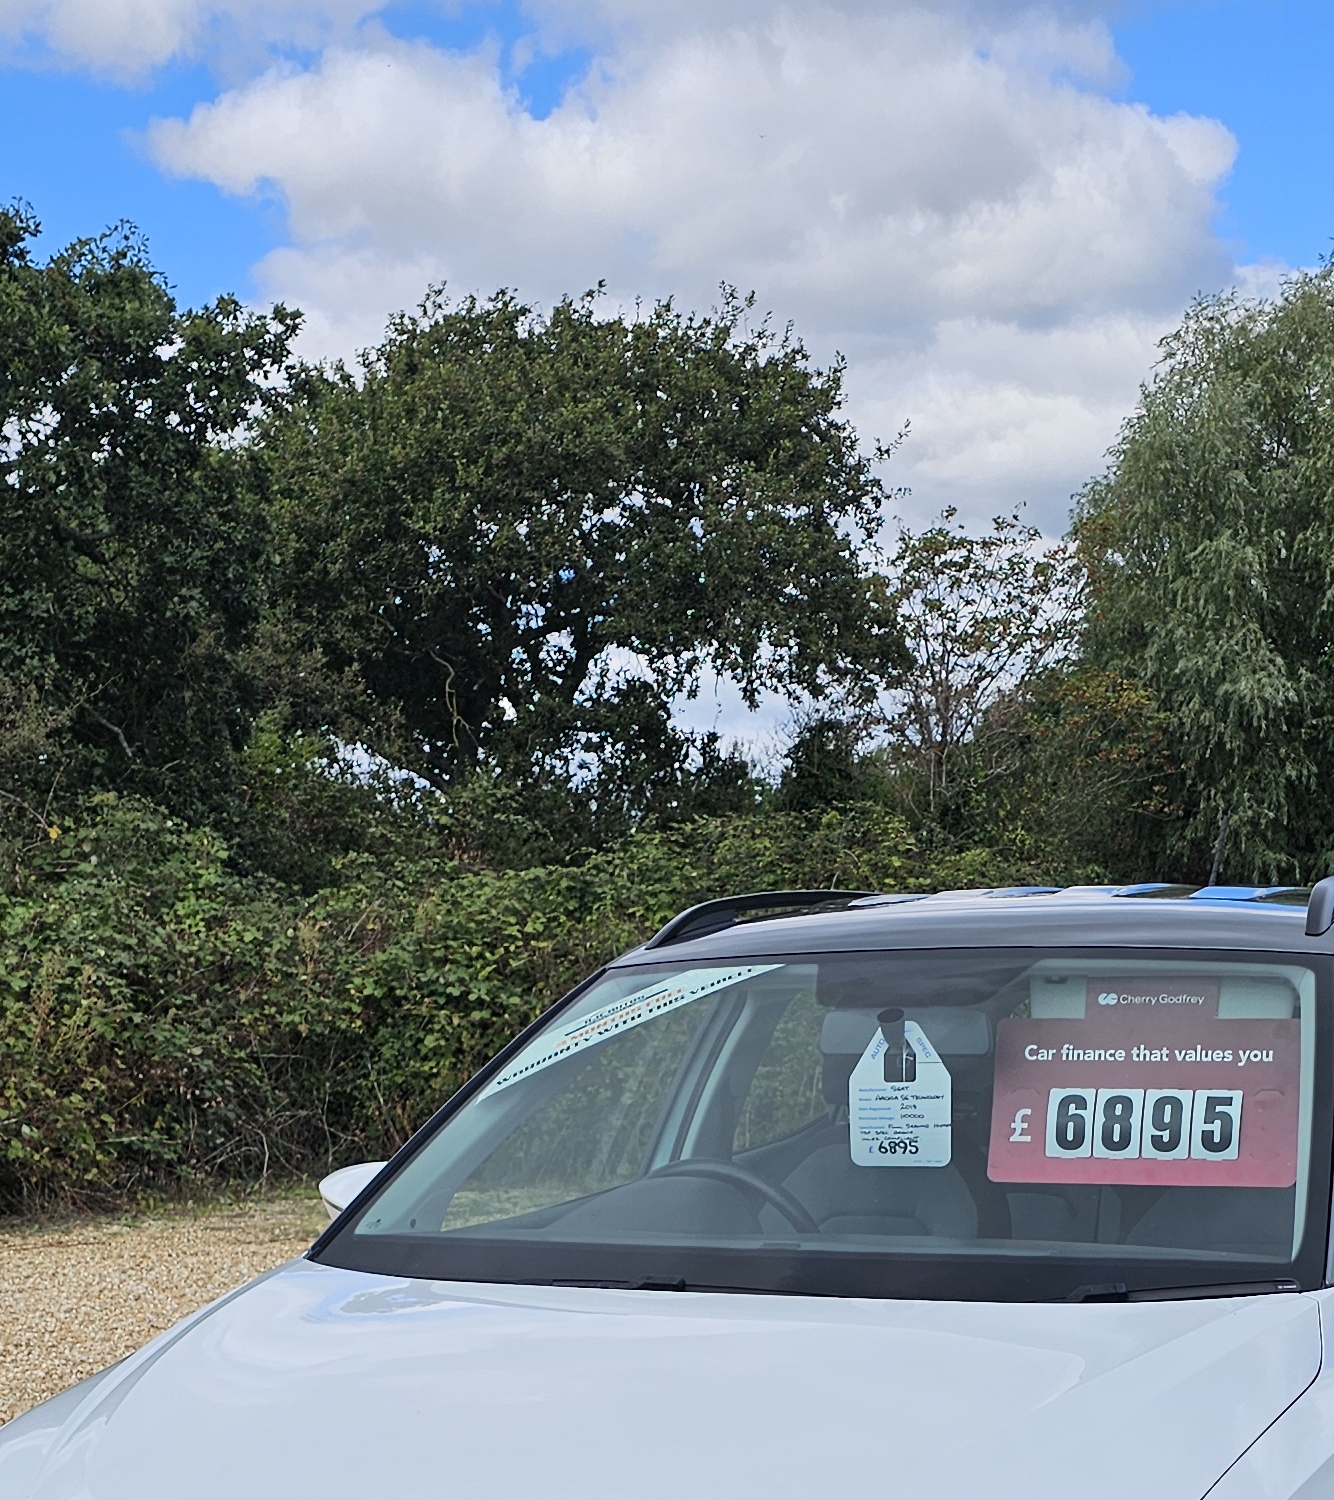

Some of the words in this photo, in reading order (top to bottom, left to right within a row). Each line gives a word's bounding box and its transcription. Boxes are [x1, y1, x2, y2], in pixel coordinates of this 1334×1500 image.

[1119, 993, 1158, 1006] Cherry
[1159, 993, 1205, 1006] Godfrey
[1024, 1044, 1056, 1062] Car
[1060, 1044, 1126, 1062] finance
[1131, 1044, 1169, 1062] that
[1174, 1044, 1233, 1063] values
[1237, 1049, 1274, 1067] you
[1009, 1108, 1033, 1143] £
[1055, 1094, 1235, 1154] 6895
[878, 1140, 920, 1155] 6895
